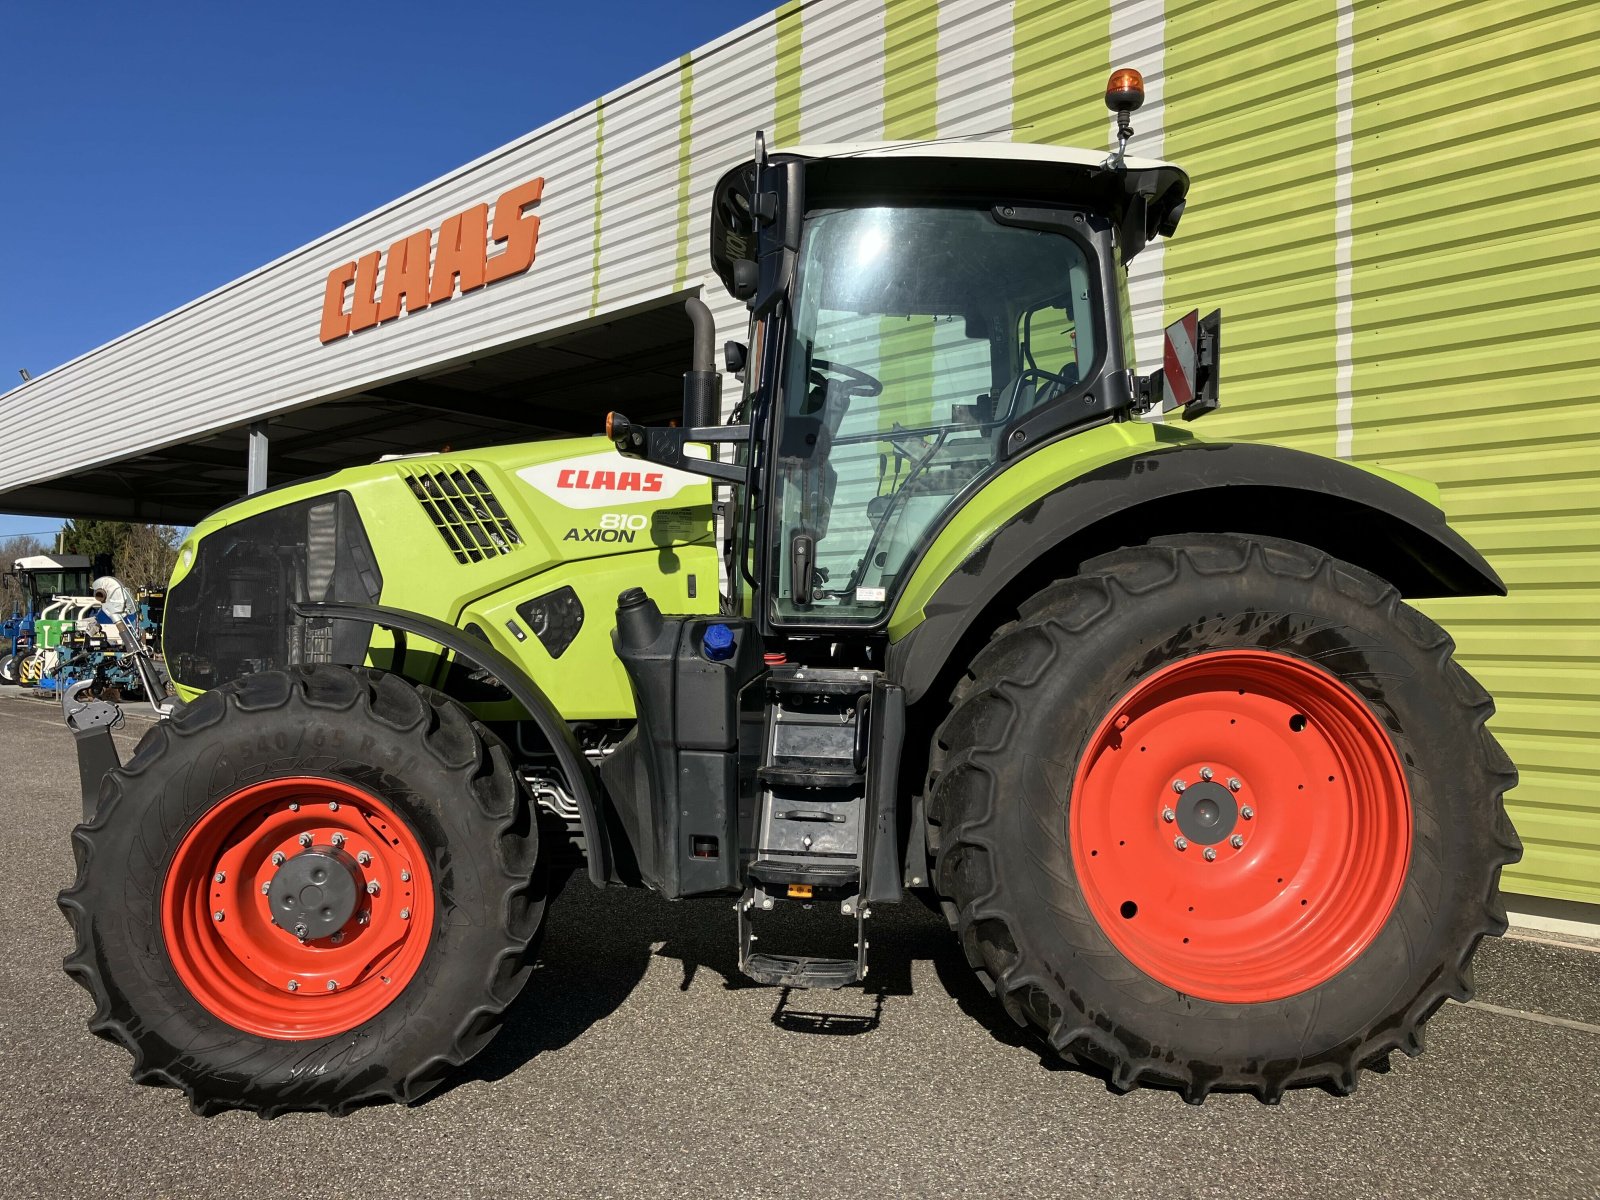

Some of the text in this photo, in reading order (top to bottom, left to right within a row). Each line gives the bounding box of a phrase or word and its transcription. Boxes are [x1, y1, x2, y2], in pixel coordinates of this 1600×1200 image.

[320, 177, 544, 344] CLAAS
[557, 469, 663, 492] CLAAS
[599, 513, 647, 530] 810
[563, 528, 636, 543] AXION
